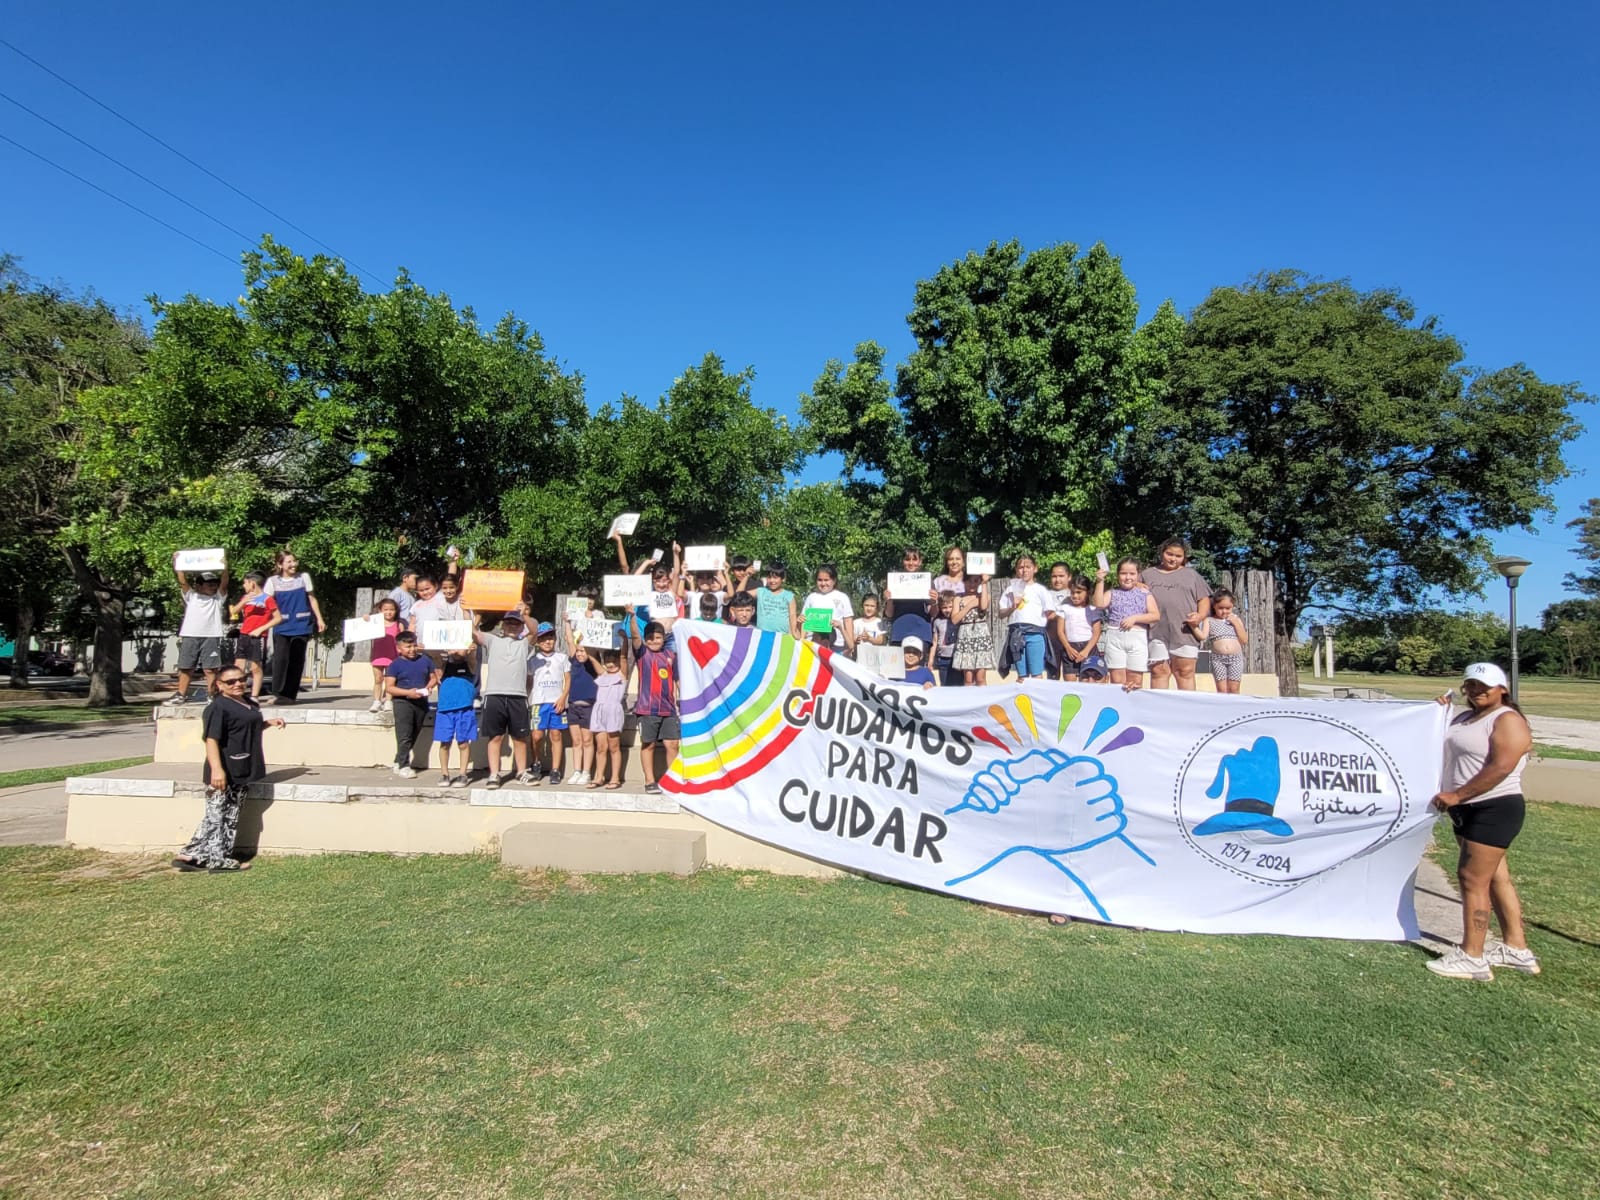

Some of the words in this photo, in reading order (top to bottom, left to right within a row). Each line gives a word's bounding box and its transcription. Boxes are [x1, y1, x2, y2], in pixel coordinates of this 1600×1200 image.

[854, 678, 928, 720] NOS
[783, 689, 975, 766] CUIDAMOS
[828, 741, 919, 795] PARA
[1289, 751, 1377, 771] GUARDERÍA
[1299, 769, 1382, 793] INFANTIL
[779, 779, 948, 863] CUIDAR
